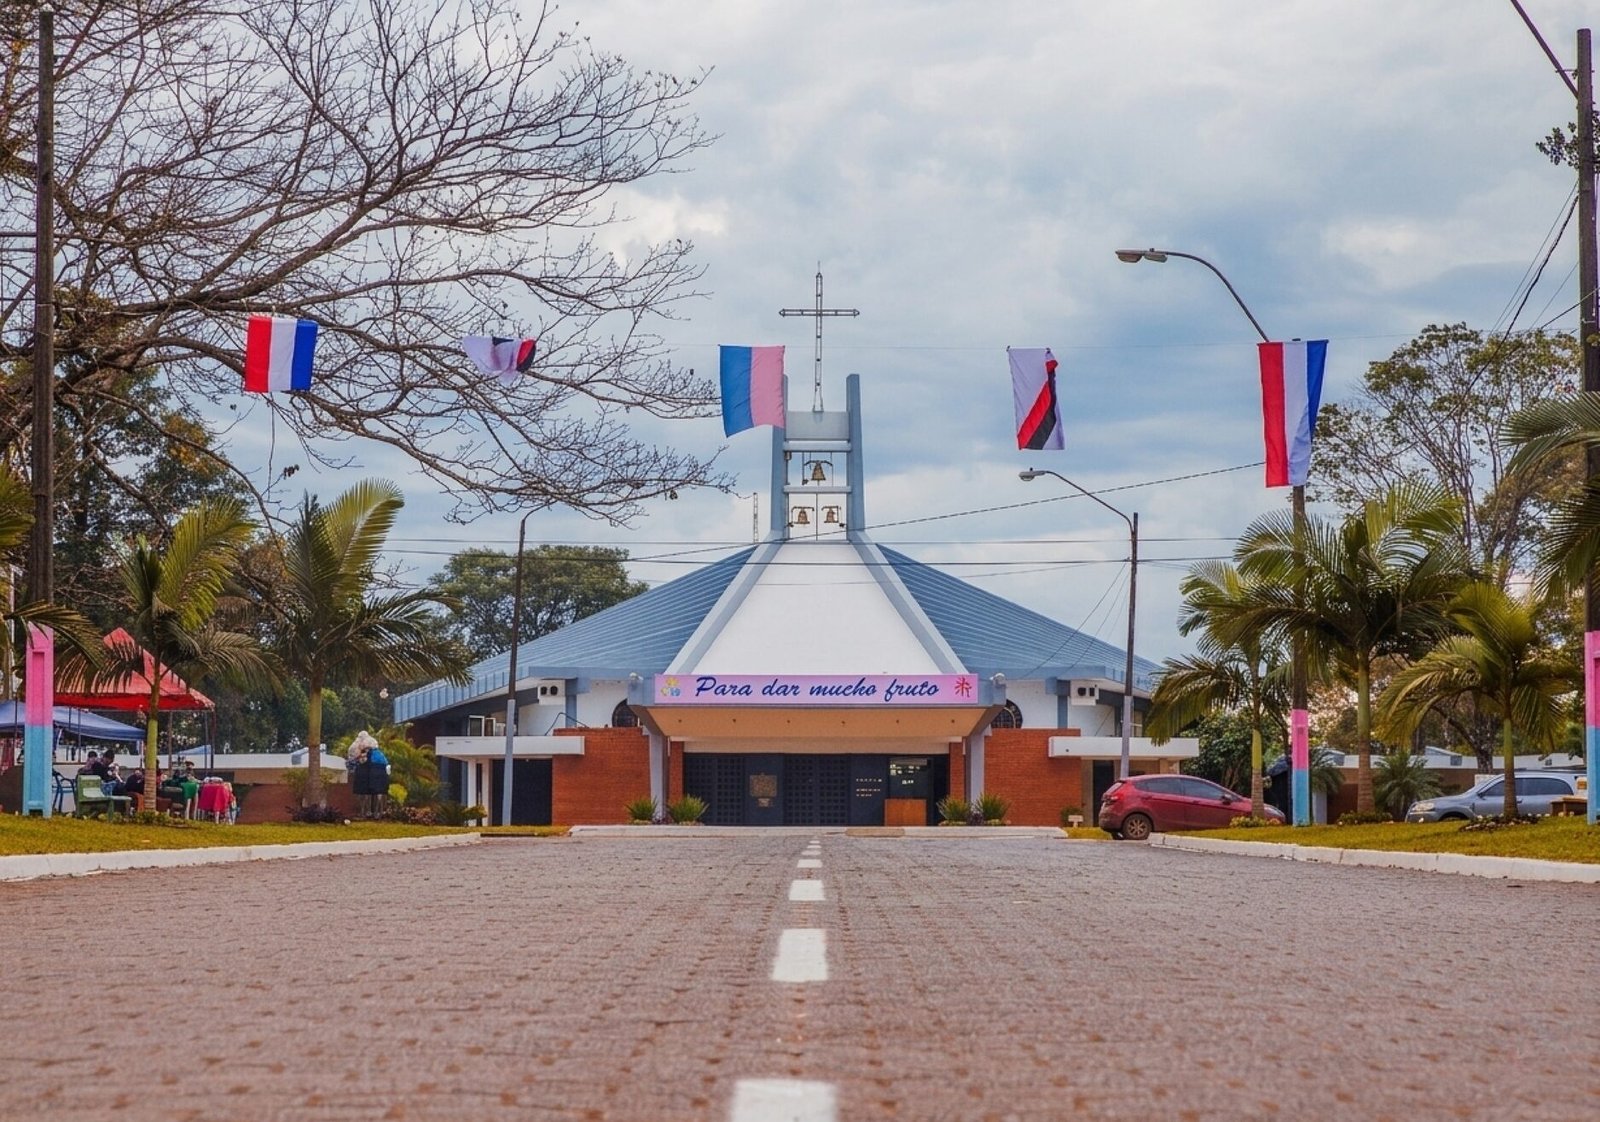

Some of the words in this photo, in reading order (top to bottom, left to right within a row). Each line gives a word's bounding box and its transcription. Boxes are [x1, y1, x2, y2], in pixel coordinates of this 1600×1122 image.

[695, 676, 753, 697] Para
[761, 678, 801, 697] dar
[808, 677, 877, 697] mucho
[884, 679, 940, 702] fruto
